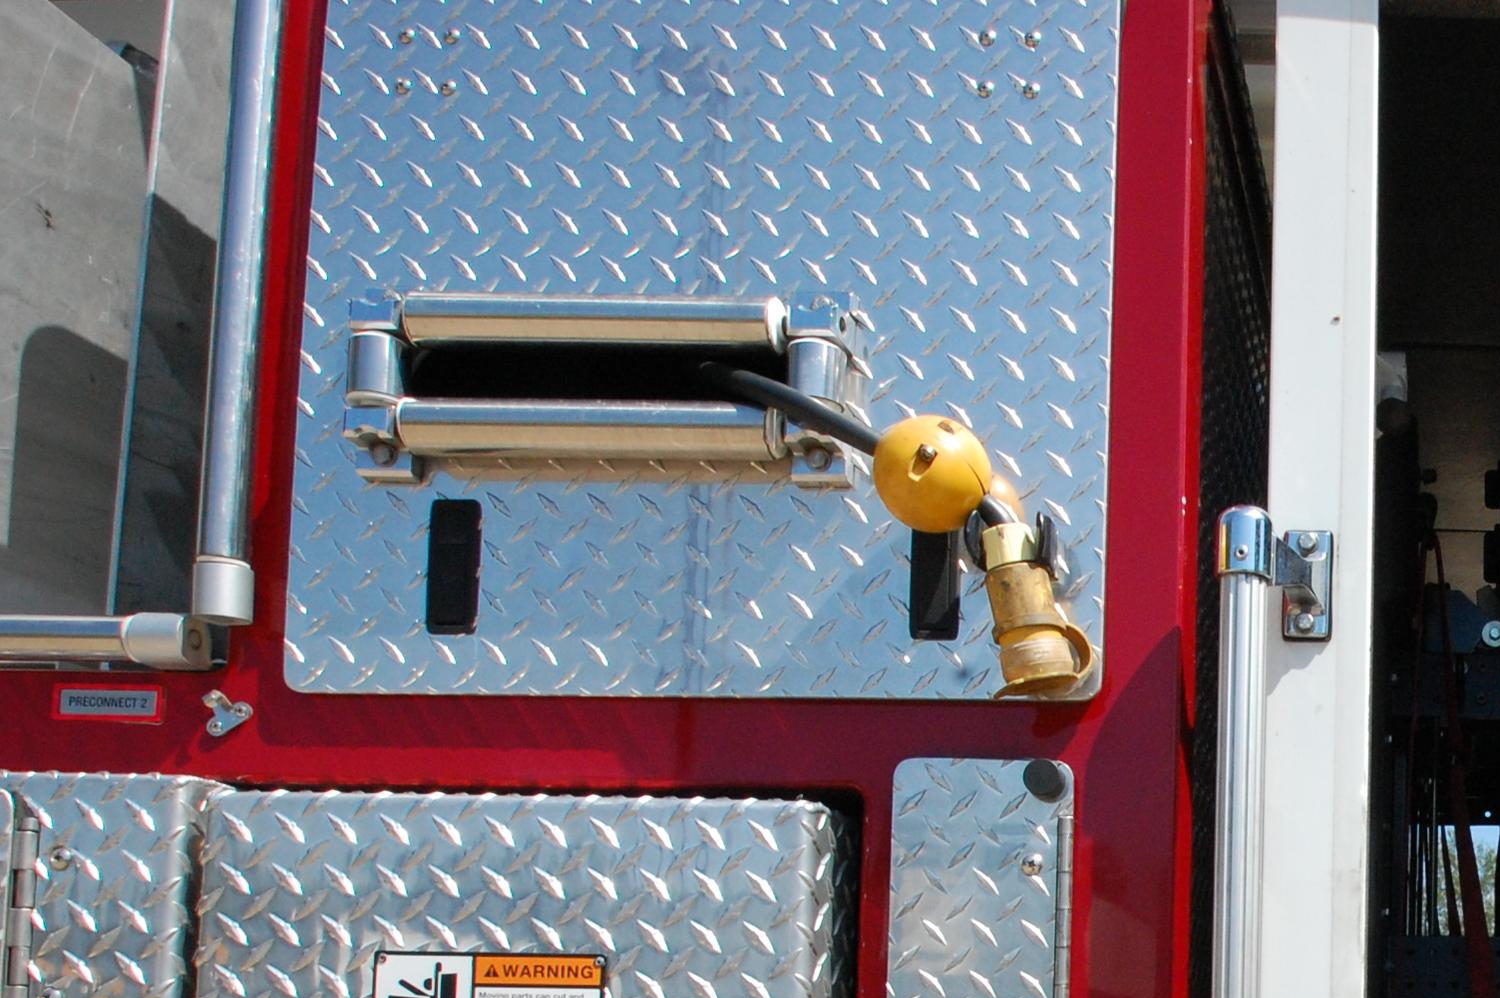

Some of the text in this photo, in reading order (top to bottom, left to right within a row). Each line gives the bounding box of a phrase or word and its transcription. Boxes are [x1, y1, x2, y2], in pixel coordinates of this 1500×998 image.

[68, 696, 148, 709] PRECONNECT 2
[502, 964, 594, 980] WARNING
